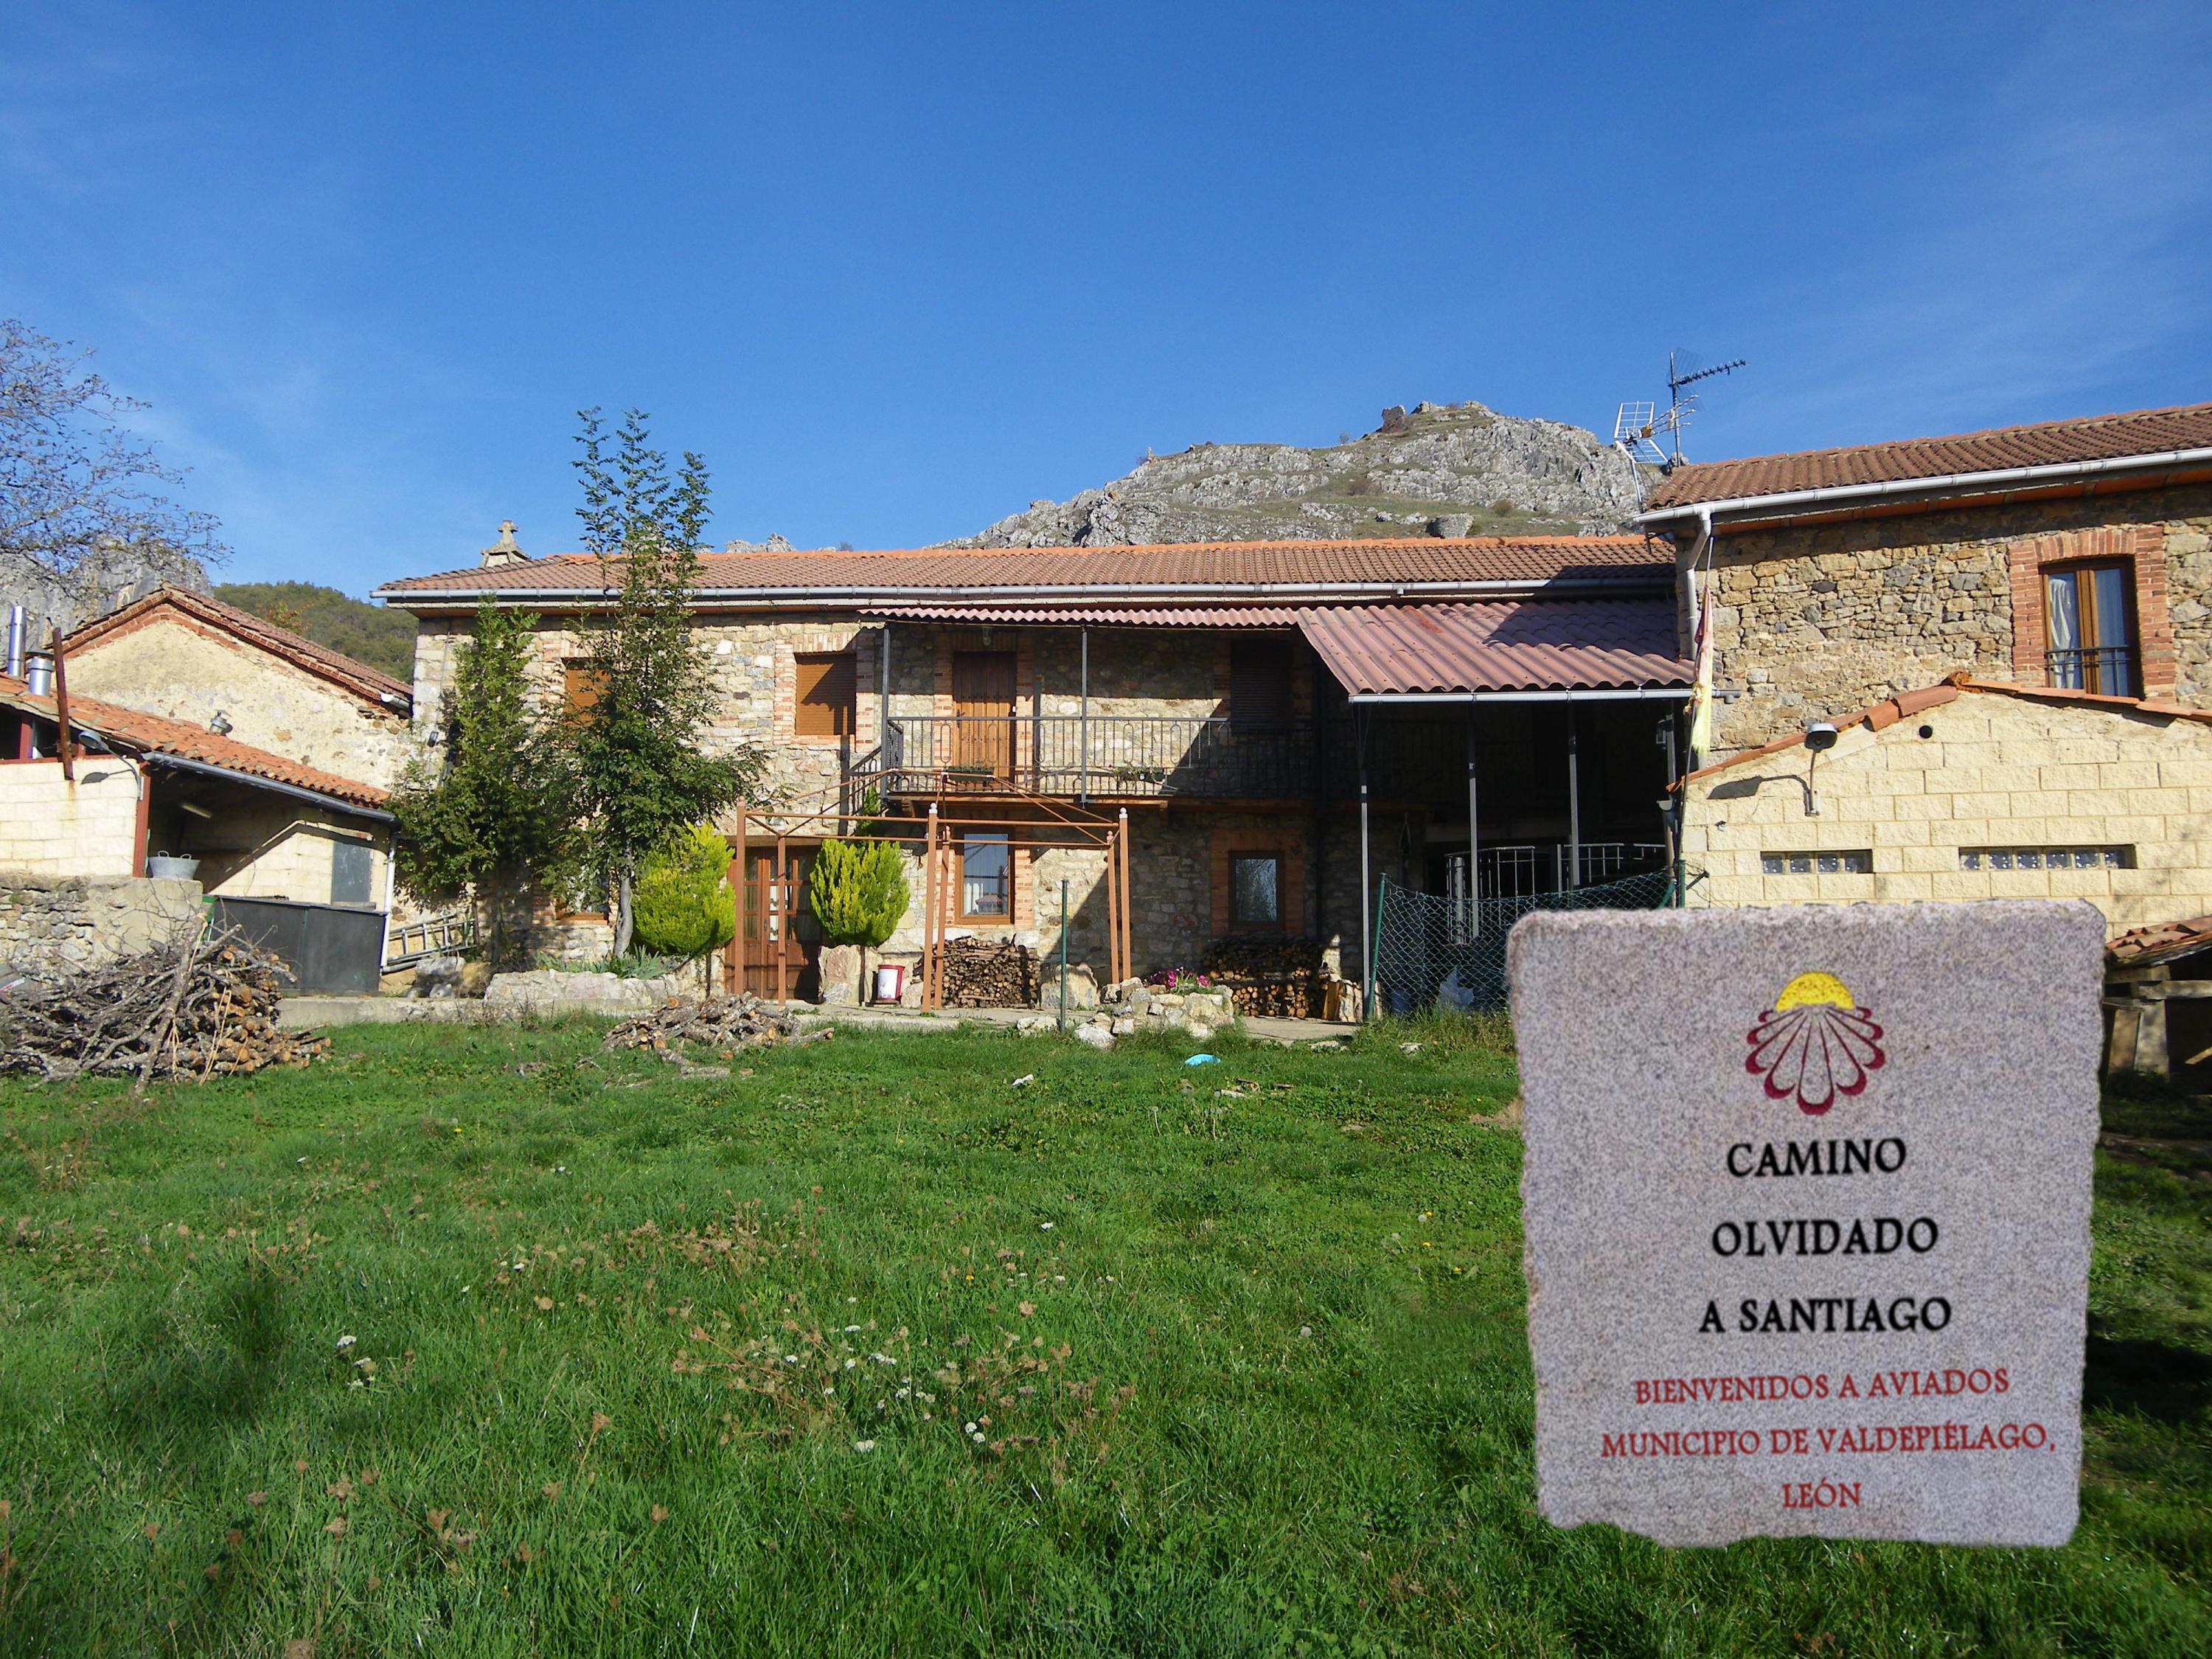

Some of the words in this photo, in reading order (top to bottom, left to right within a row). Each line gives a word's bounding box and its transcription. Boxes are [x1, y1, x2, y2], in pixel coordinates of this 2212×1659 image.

[1726, 1137, 1907, 1178] CAMINO
[1711, 1217, 1940, 1257] OLVIDADO
[1697, 1300, 1727, 1334] A
[1739, 1297, 1952, 1334] SANTIAGO
[1635, 1374, 1830, 1405] BIENVENIDOS
[1838, 1374, 1860, 1399] A
[1867, 1367, 2011, 1397] AVIADOS
[1600, 1430, 1761, 1458] MUNICIPIO
[1770, 1428, 1809, 1455] DE
[1817, 1419, 2056, 1453] VALDEPIÉLAGO,
[1782, 1477, 1862, 1509] LEÓN
